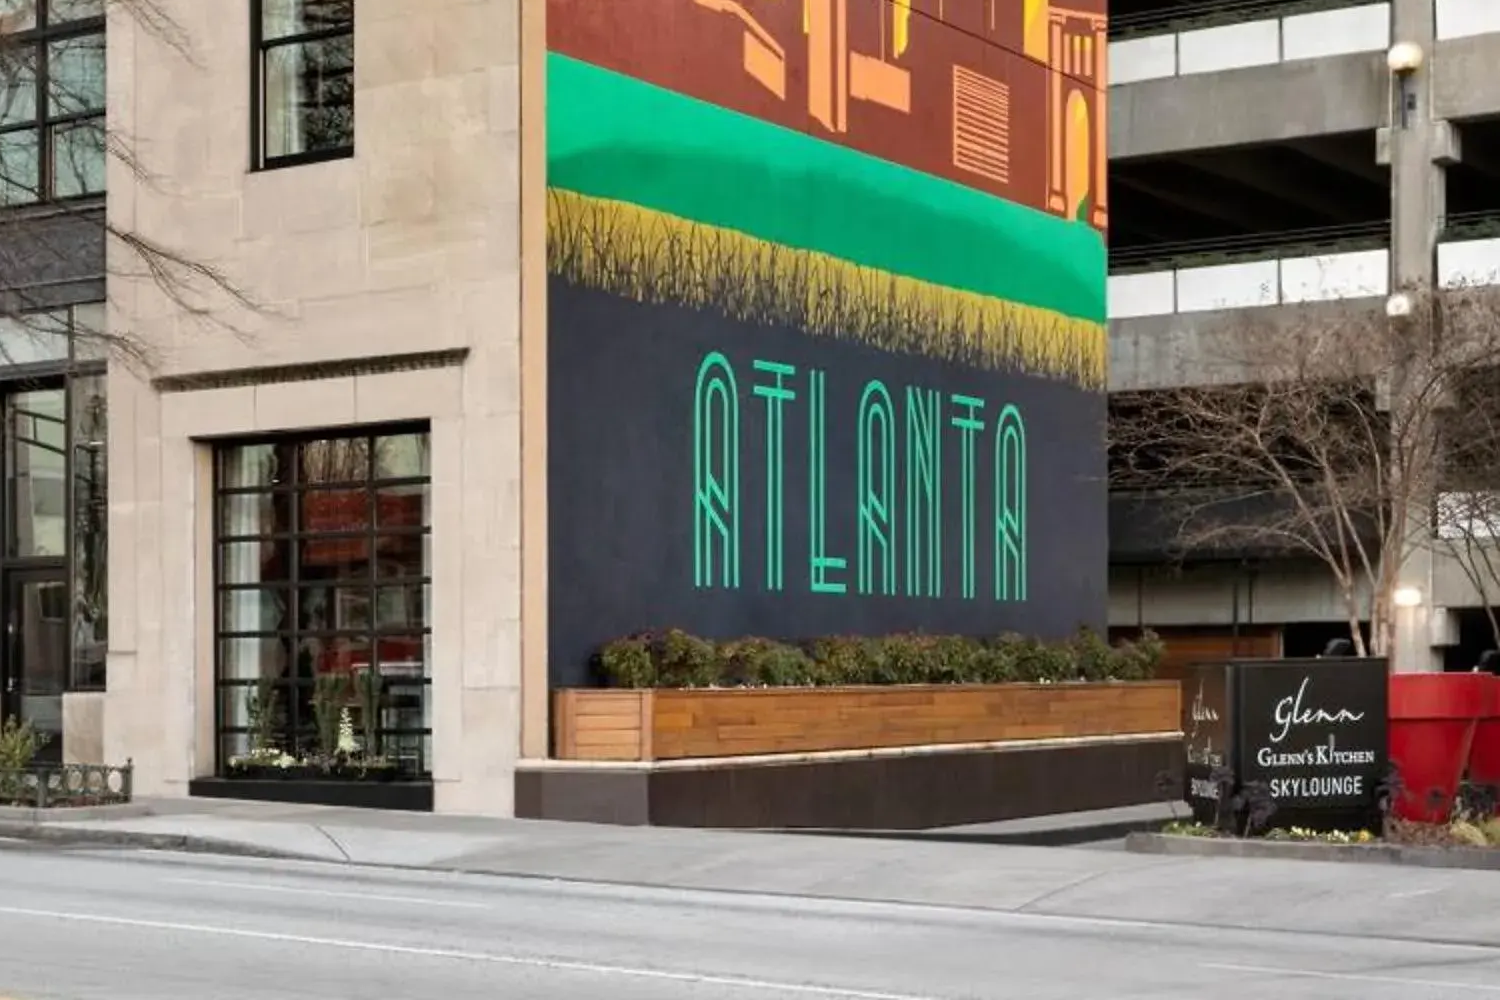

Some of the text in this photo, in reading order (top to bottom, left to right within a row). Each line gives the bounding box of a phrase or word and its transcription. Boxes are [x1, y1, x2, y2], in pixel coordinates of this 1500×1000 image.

[694, 351, 1027, 601] ATLANTA
[1269, 676, 1365, 743] Glenn
[1270, 776, 1363, 798] SKYLOUNGE
